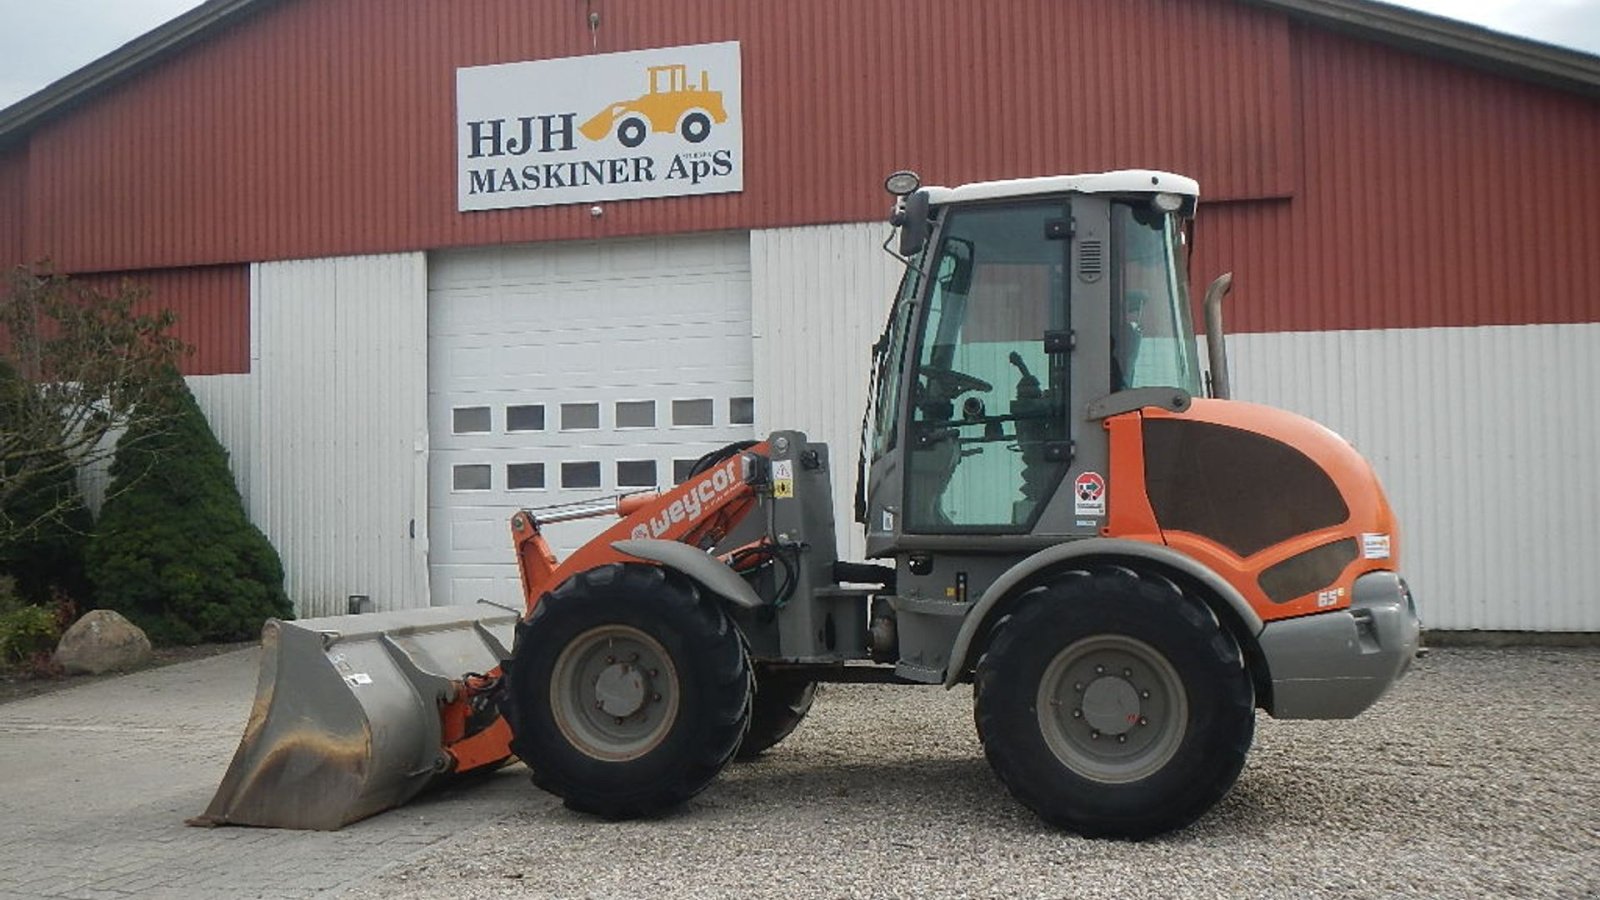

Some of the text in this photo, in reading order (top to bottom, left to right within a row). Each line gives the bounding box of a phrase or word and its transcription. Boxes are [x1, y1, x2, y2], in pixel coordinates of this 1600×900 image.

[467, 113, 577, 158] HJH
[468, 150, 732, 194] MASKINER ApS
[649, 461, 737, 537] weycor
